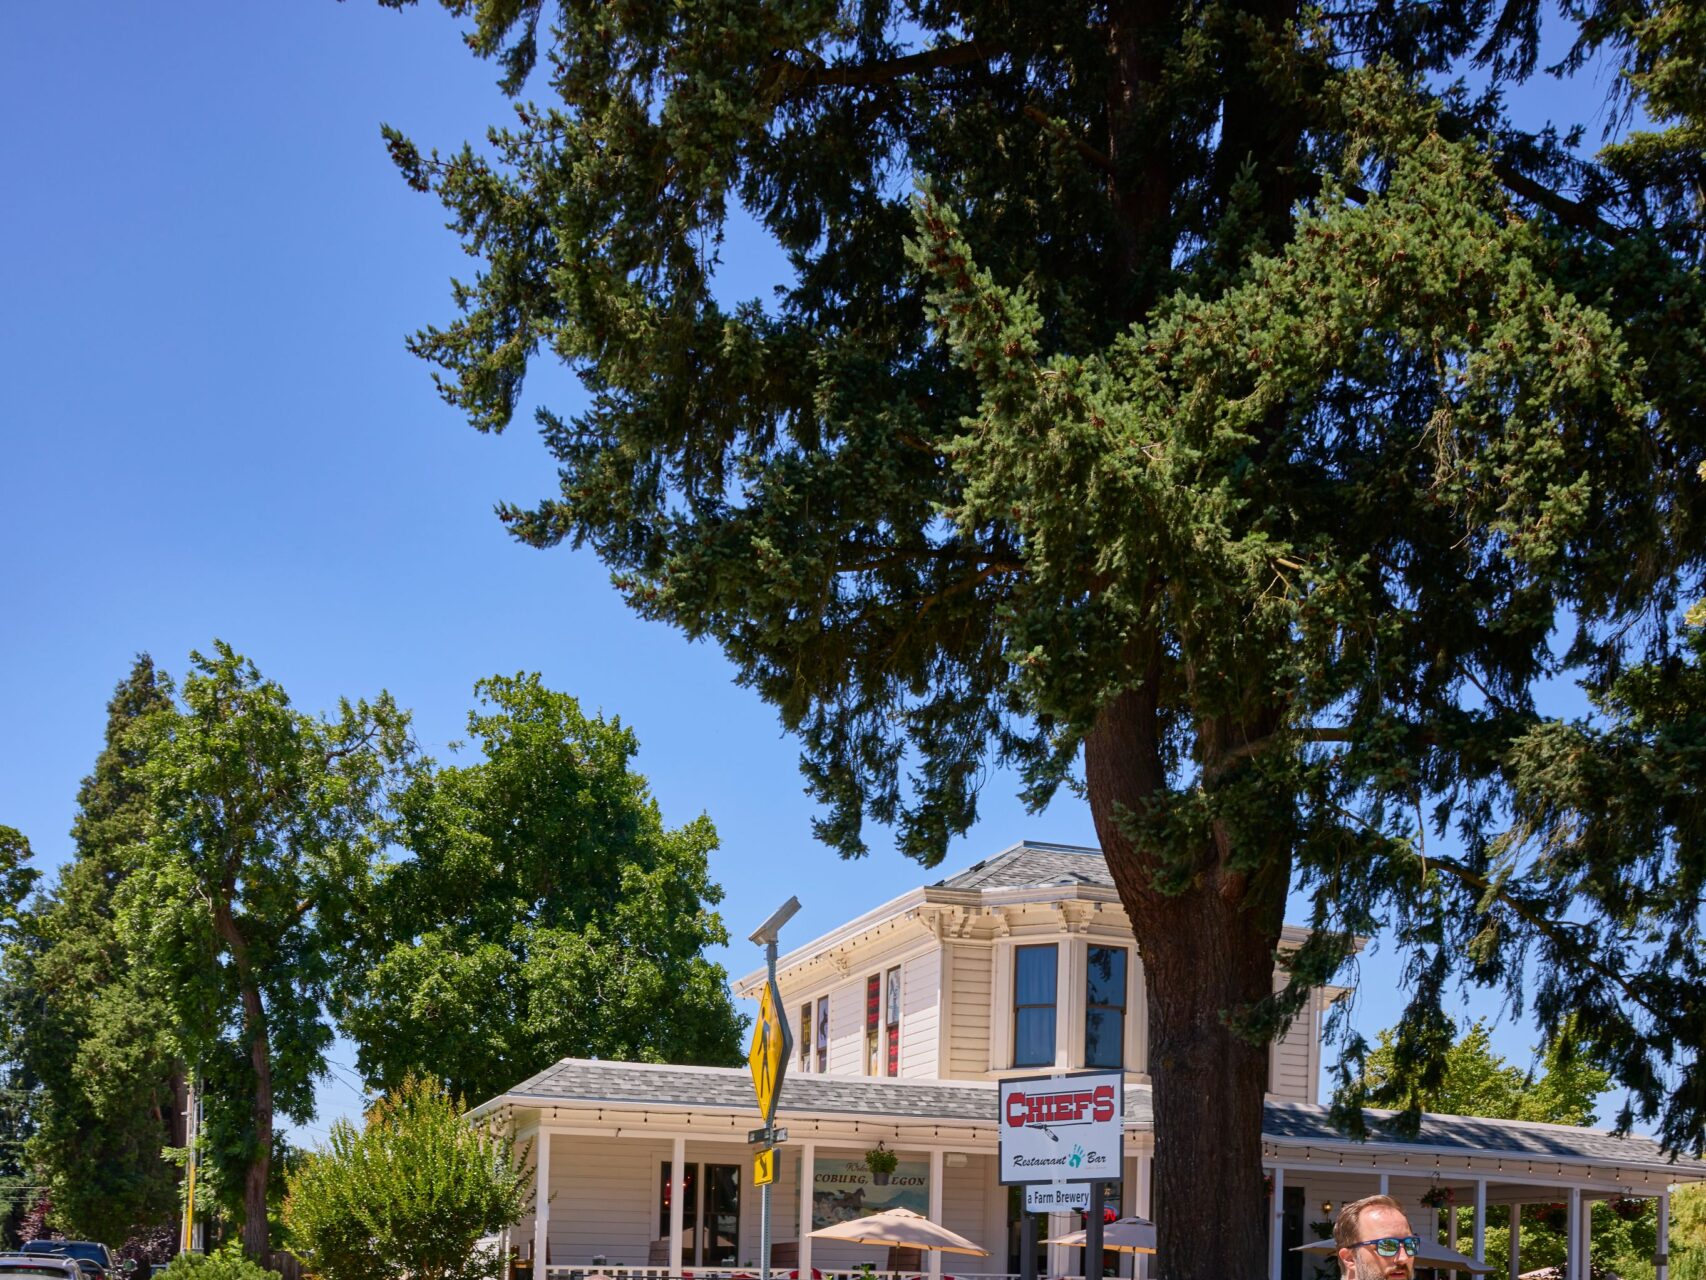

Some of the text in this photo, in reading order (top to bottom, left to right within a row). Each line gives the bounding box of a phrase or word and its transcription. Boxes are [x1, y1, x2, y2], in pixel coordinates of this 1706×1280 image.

[1013, 1151, 1106, 1168] Restaurant Bar
[1027, 1190, 1090, 1206] a Farm Brewery
